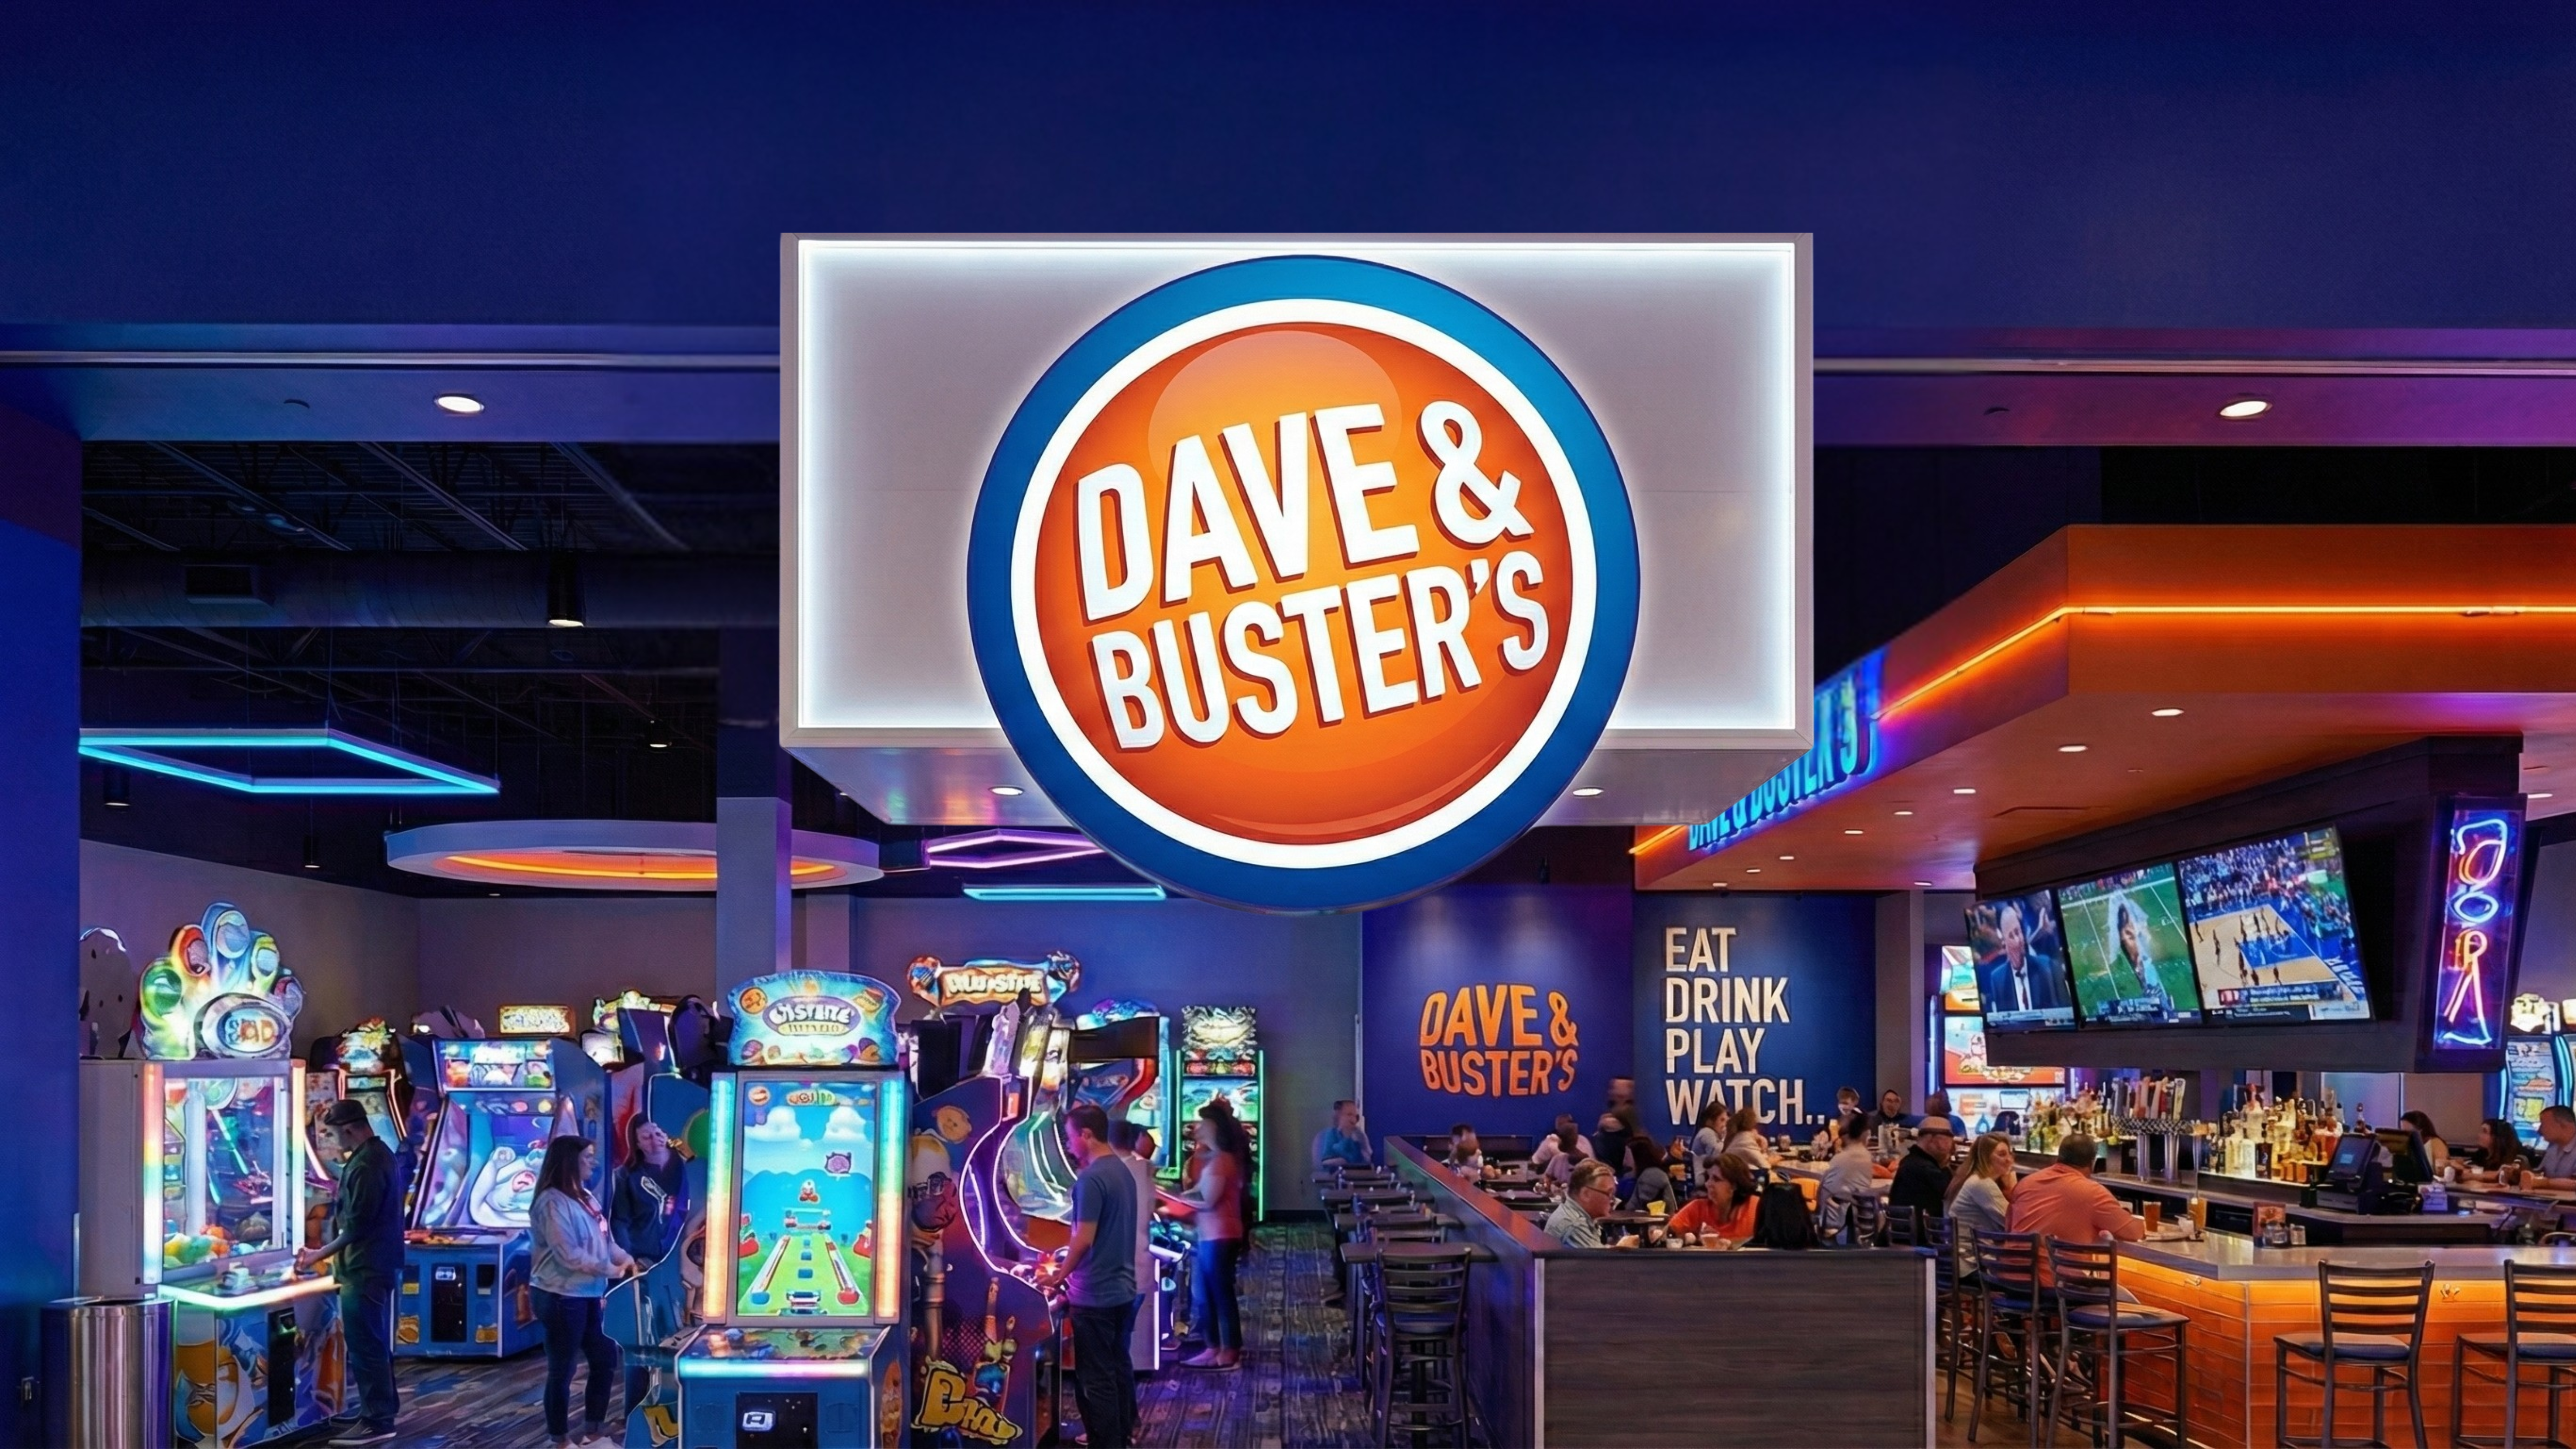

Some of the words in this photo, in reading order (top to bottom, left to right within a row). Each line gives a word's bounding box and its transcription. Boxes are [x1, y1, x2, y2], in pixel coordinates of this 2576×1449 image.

[1076, 403, 1420, 621] DAVE
[1420, 400, 1534, 544] &
[1091, 551, 1549, 749] BUSTER'S
[1666, 927, 1737, 972] EAT
[1420, 984, 1543, 1047] DAVE
[1548, 992, 1579, 1047] &
[1666, 977, 1790, 1023] DRINK
[1420, 1049, 1579, 1097] BUSTER'S
[1666, 1028, 1766, 1073] PLAY
